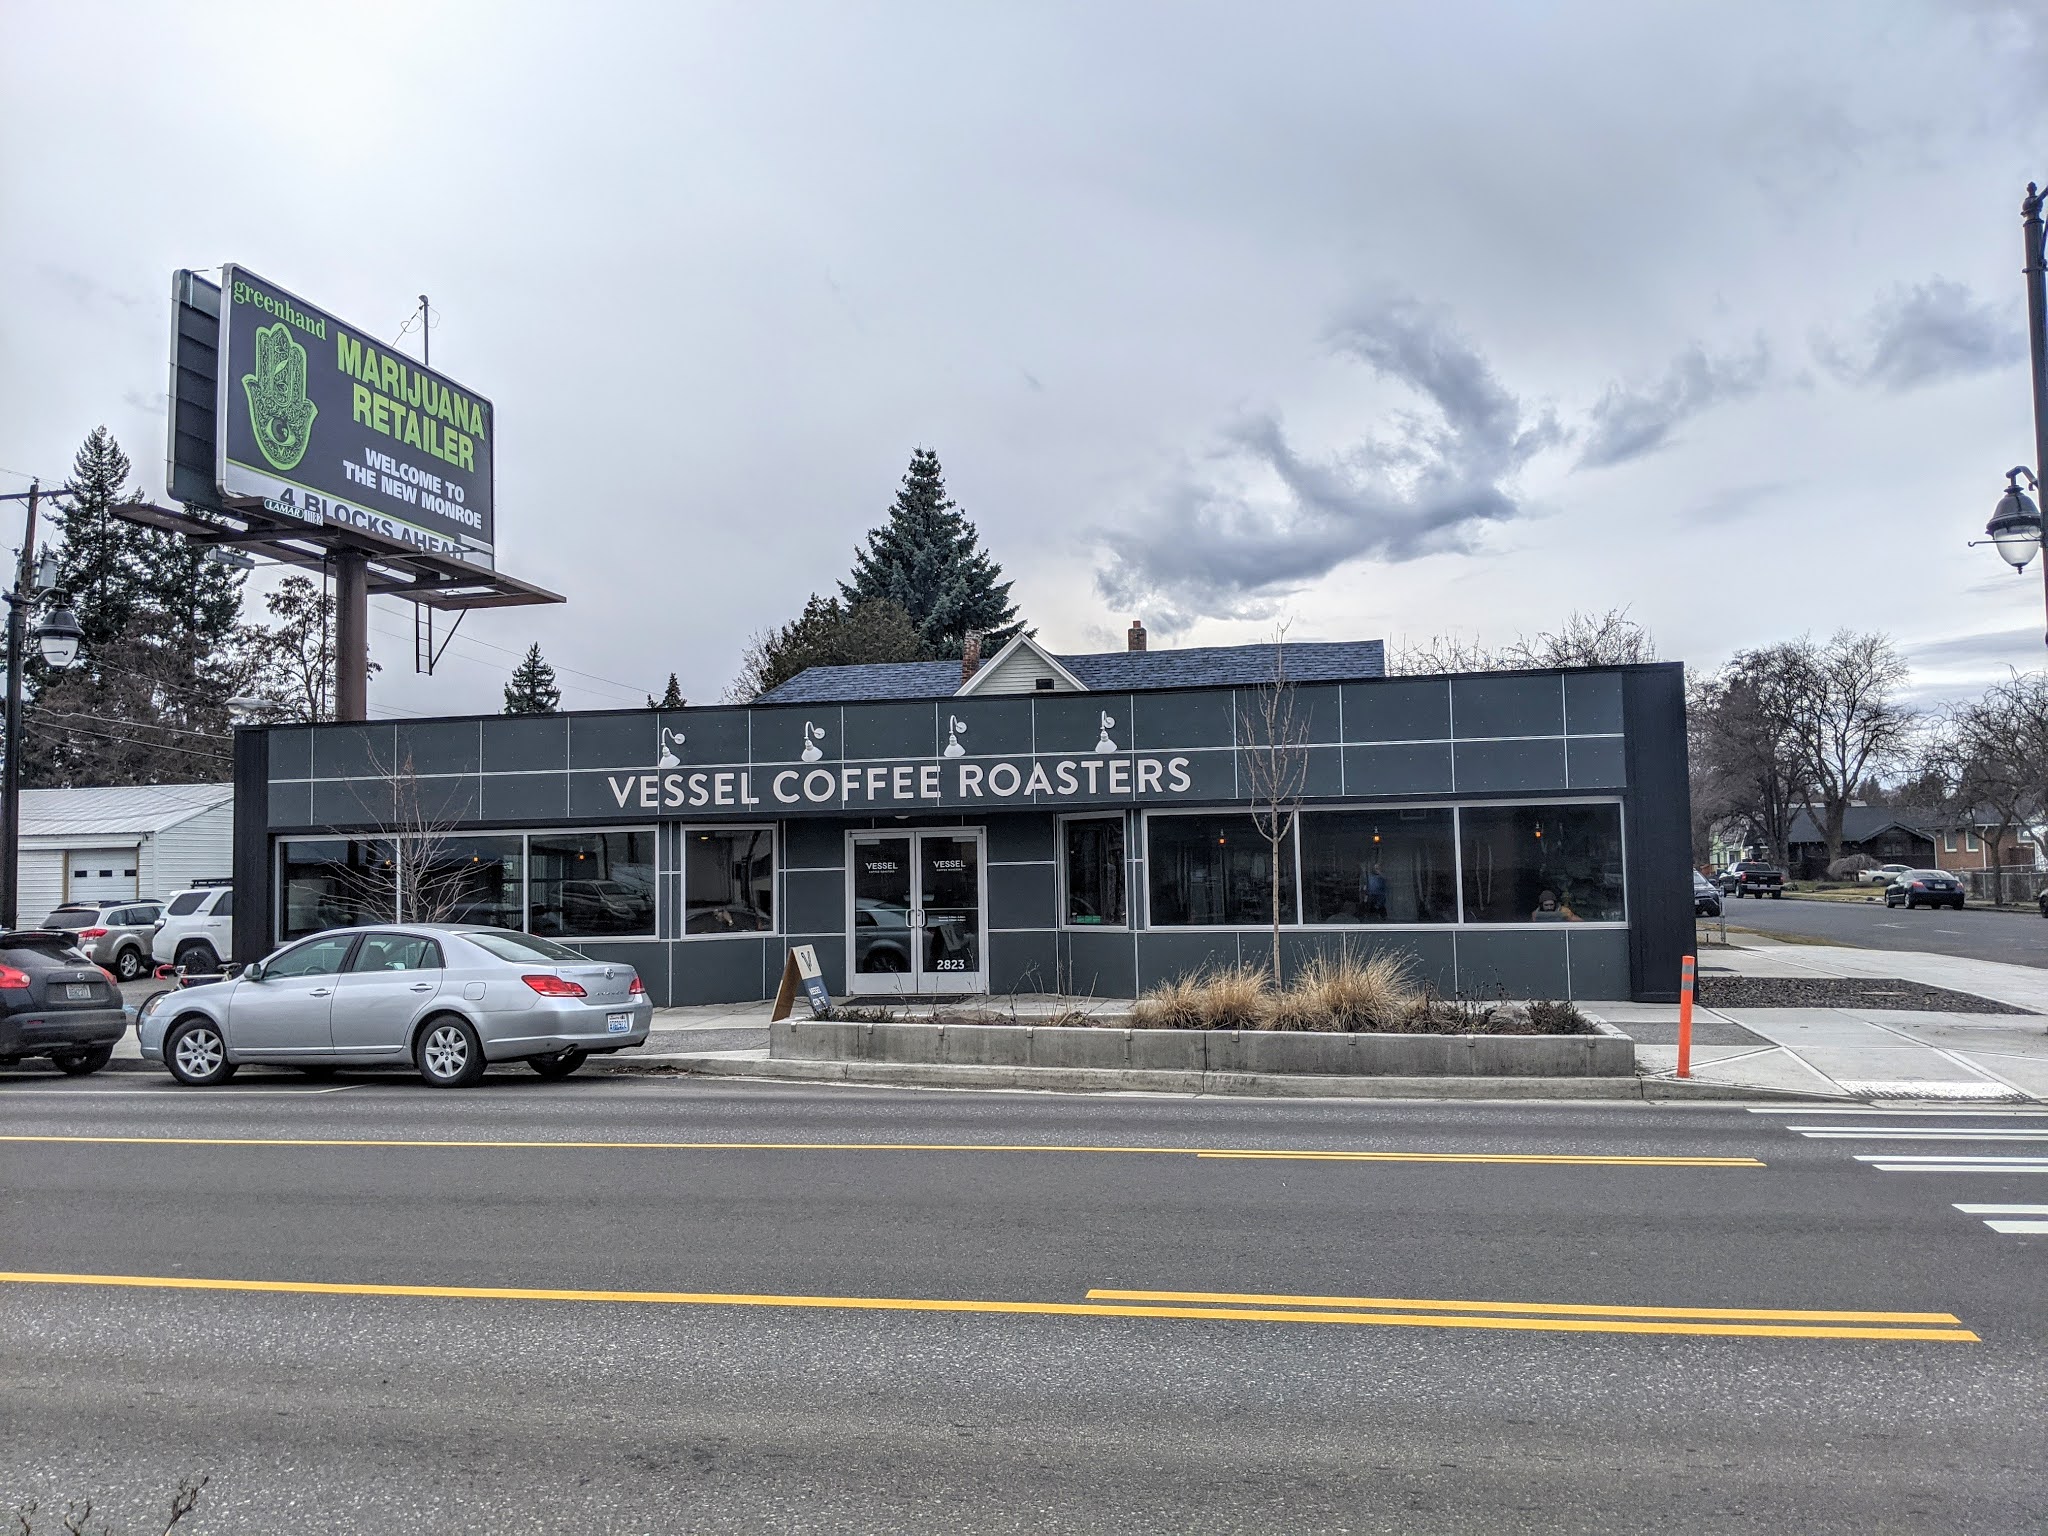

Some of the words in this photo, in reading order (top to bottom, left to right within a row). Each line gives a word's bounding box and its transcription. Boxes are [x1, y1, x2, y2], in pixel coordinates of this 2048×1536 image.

[233, 281, 327, 341] greenhand
[337, 331, 485, 441] MARIJUANA
[353, 382, 474, 473] RETAILER
[342, 460, 377, 489] THE
[381, 475, 418, 504] NEW
[421, 490, 482, 530] MONROE
[365, 447, 442, 495] WELCOME
[445, 480, 465, 503] TO
[268, 501, 301, 518] LAMAR
[280, 487, 296, 507] 4
[304, 492, 394, 539] BLOCKS
[607, 772, 760, 808] VESSEL
[773, 764, 942, 803] COFFEE
[959, 756, 1192, 797] ROASTERS
[865, 862, 899, 870] VESSEL
[932, 859, 967, 868] VESSEL
[936, 959, 965, 970] 2823
